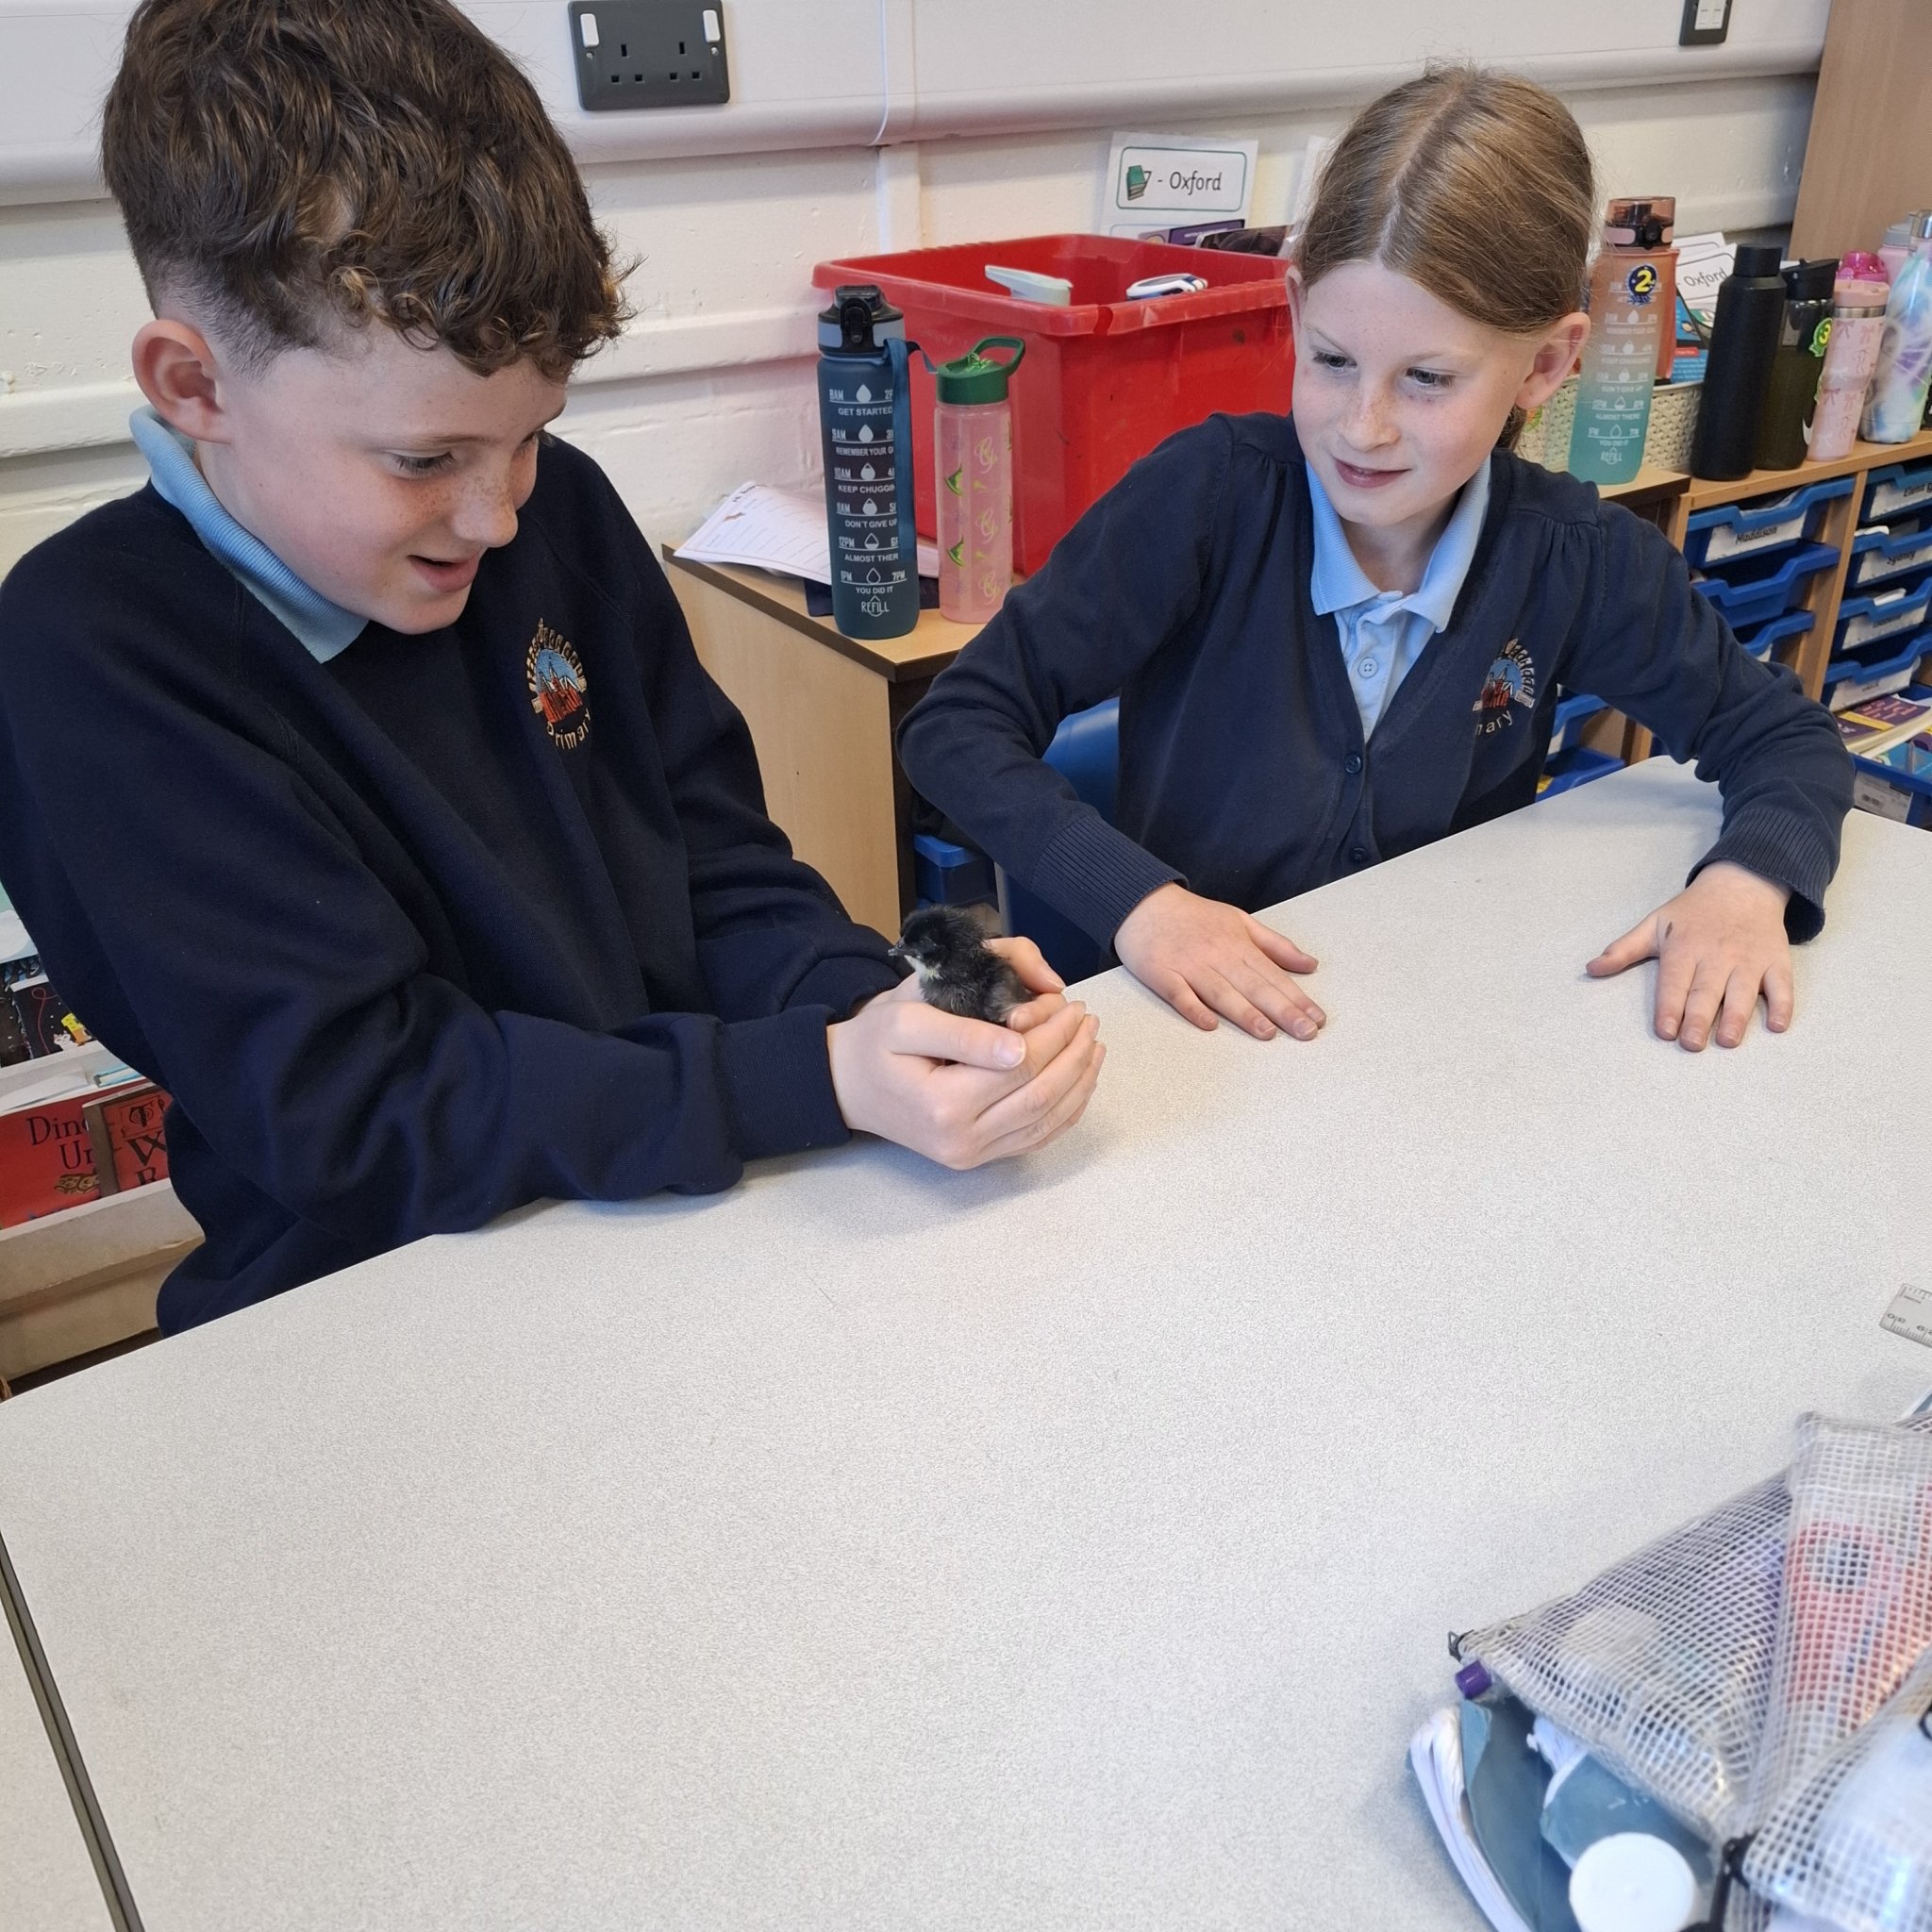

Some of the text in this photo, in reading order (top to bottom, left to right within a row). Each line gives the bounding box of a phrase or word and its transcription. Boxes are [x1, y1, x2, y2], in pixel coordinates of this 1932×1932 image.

[1169, 170, 1222, 195] Oxford
[1635, 269, 1652, 292] 2
[1683, 267, 1728, 287] Oxford
[1819, 324, 1831, 344] 3
[838, 406, 893, 416] GET STARTED
[836, 446, 869, 457] REMEMBER
[869, 446, 887, 457] YOUR
[838, 484, 858, 493] KEEP
[869, 520, 888, 528] GIVE
[844, 553, 899, 562] ALMOST THER
[860, 601, 890, 613] REFILL
[26, 1115, 91, 1147] Din
